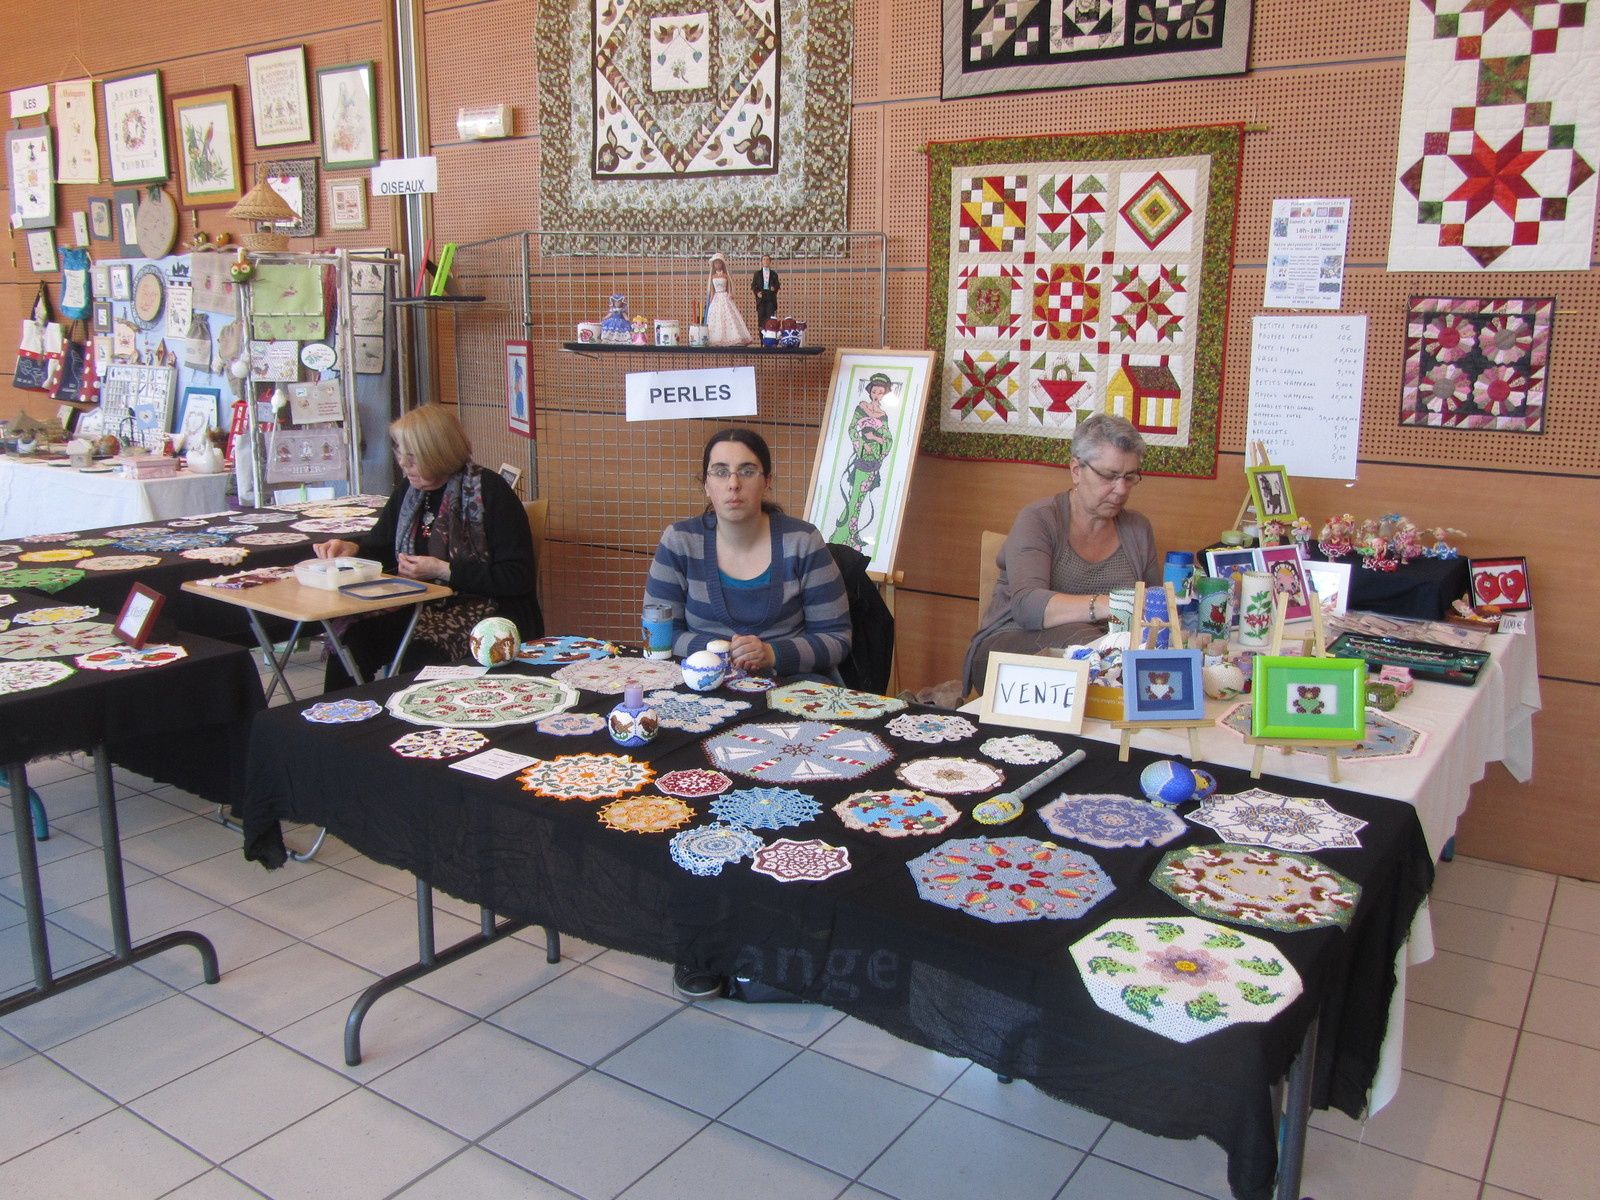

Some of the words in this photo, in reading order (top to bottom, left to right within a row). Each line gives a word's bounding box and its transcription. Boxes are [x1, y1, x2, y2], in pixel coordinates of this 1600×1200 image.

[23, 98, 37, 109] ILES
[380, 179, 425, 194] OISEAUX
[649, 383, 732, 404] PERLES
[1252, 428, 1288, 436] BRACELETS
[1000, 681, 1075, 708] VENTE
